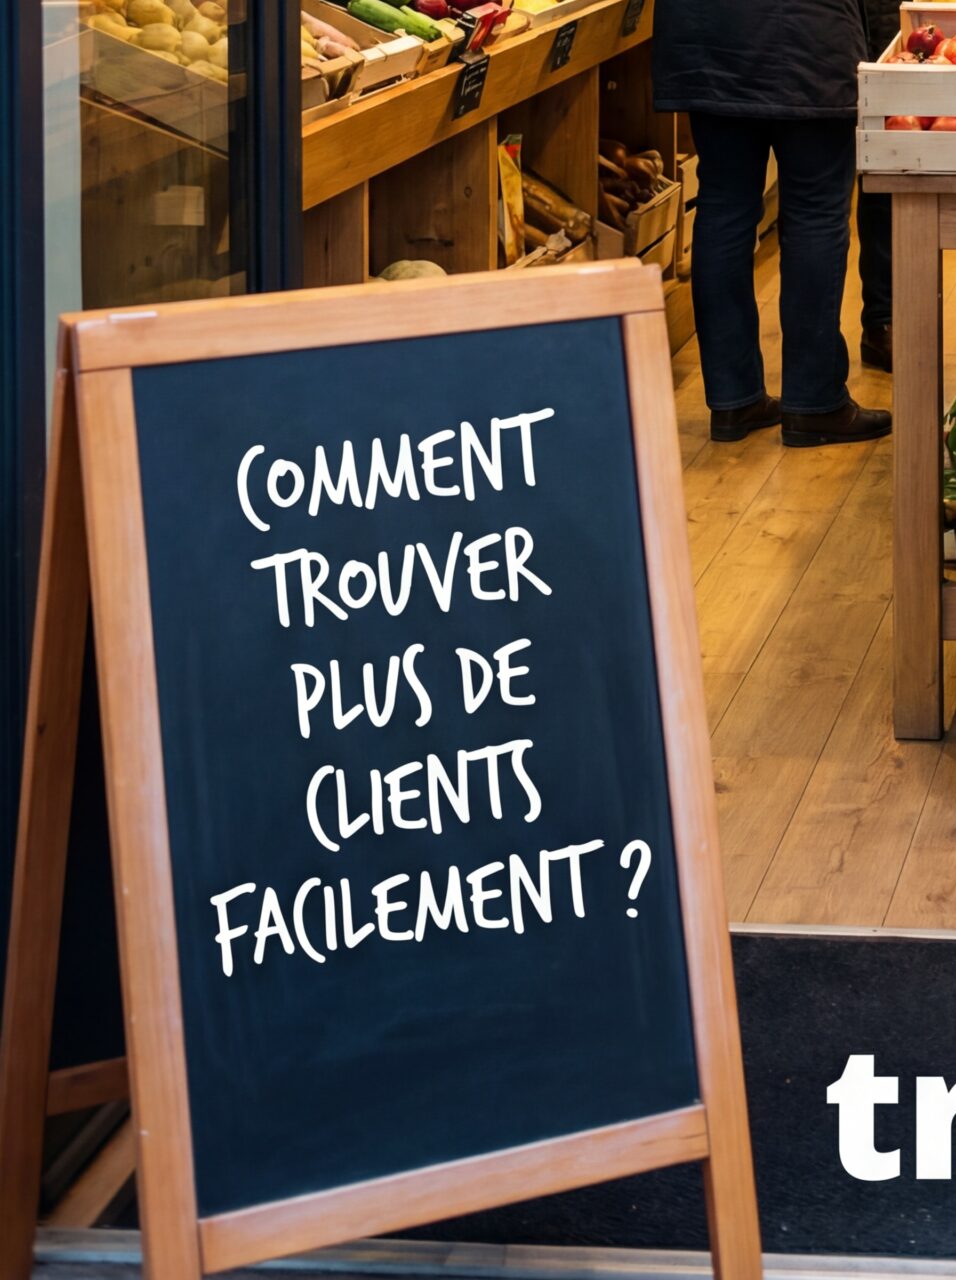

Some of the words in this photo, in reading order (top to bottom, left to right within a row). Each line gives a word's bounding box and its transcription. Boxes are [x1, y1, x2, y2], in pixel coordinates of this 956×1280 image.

[236, 407, 555, 532] COMMENT
[250, 526, 553, 628] TROUVER
[290, 643, 433, 739] PLUS
[455, 638, 536, 714] DE
[306, 738, 542, 853] CLIENTS
[209, 838, 605, 977] FACILEMENT
[619, 839, 652, 919] ?
